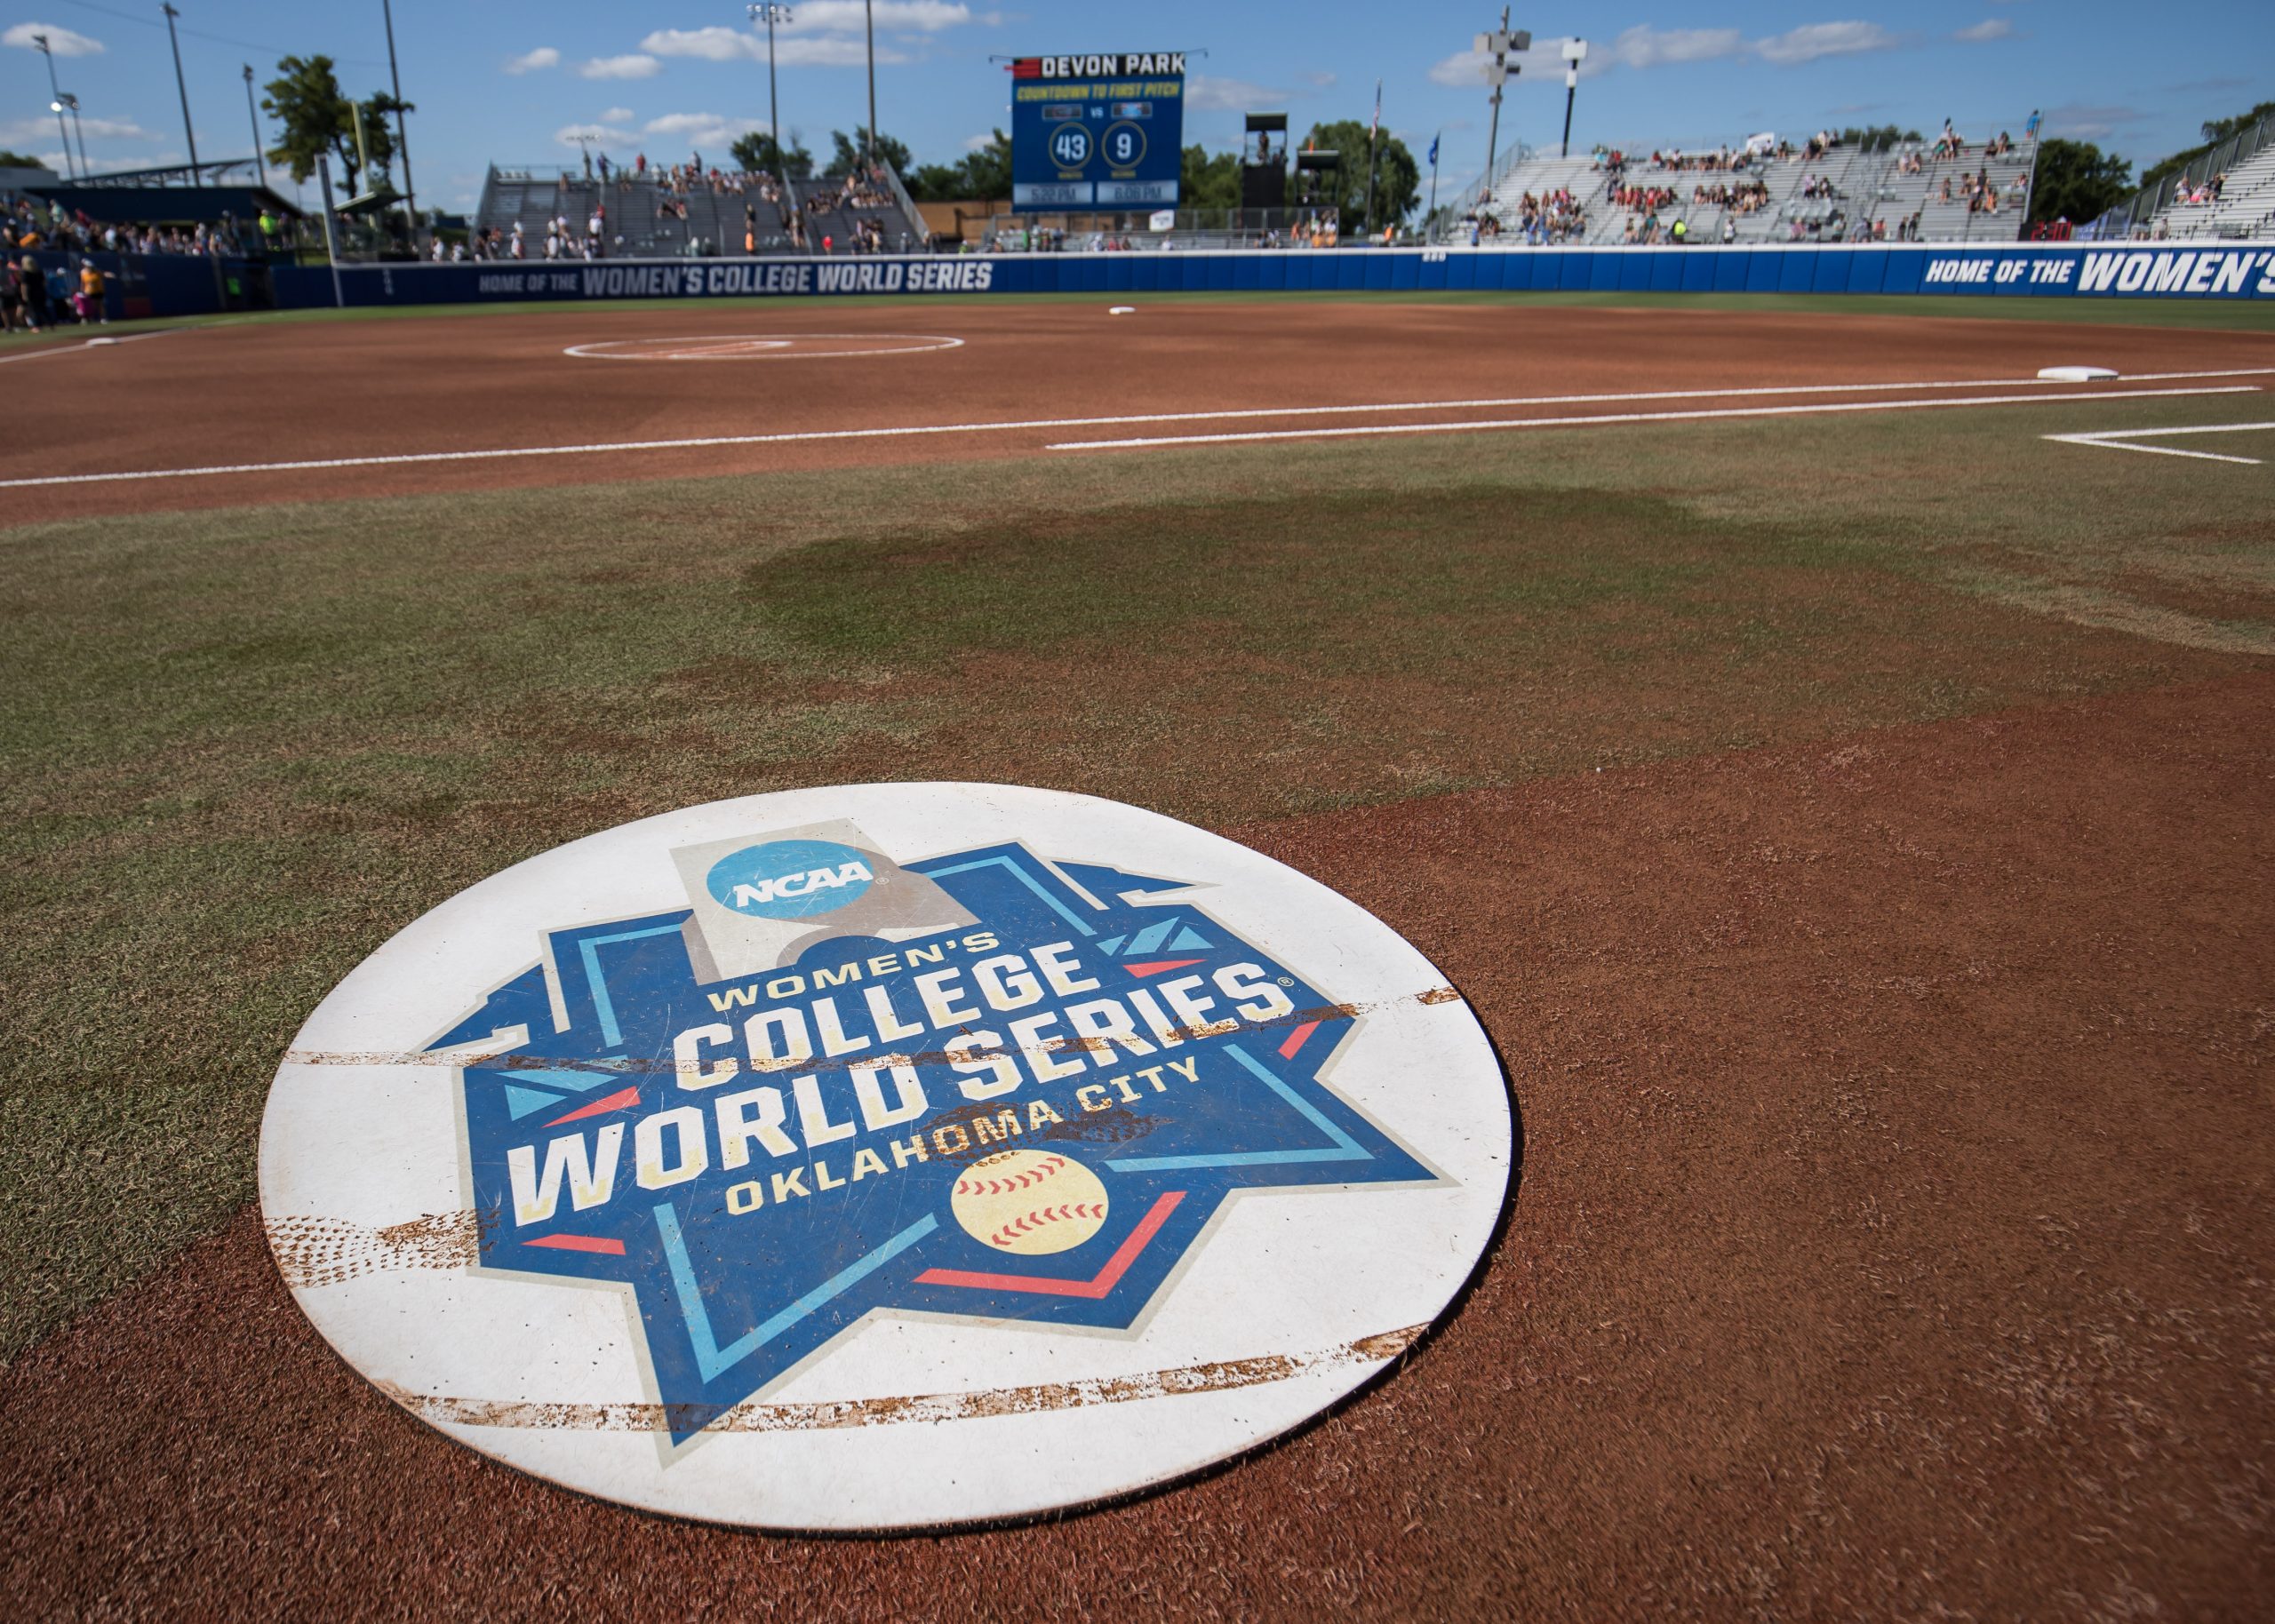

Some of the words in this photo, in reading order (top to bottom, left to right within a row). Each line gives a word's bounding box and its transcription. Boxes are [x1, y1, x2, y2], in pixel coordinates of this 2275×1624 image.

[1042, 56, 1117, 77] DEVON
[1126, 53, 1185, 75] PARK
[1017, 85, 1090, 102] COUNTDOWN
[1092, 84, 1107, 100] TO
[1108, 82, 1143, 99] FIRST
[1144, 81, 1180, 98] PITCH
[1056, 134, 1086, 160] 43
[1116, 133, 1132, 159] 9
[1058, 187, 1076, 201] PM
[1144, 185, 1162, 199] PM
[479, 275, 524, 293] HOME
[527, 274, 547, 291] OF
[551, 274, 578, 291] THE
[582, 267, 704, 296] WOMEN'S
[707, 265, 810, 293] COLLEGE
[818, 264, 903, 291] WORLD
[906, 262, 992, 290] SERIES
[1926, 259, 1991, 283] HOME
[1993, 259, 2026, 283] OF
[2030, 259, 2076, 283] THE
[733, 861, 874, 908] NCAA
[706, 932, 1000, 1013] WOMEN'S
[672, 941, 1101, 1092] COLLEGE
[507, 1055, 930, 1227] WORLD
[725, 1099, 1064, 1216] OKLAHOMA
[1075, 1055, 1201, 1113] CITY
